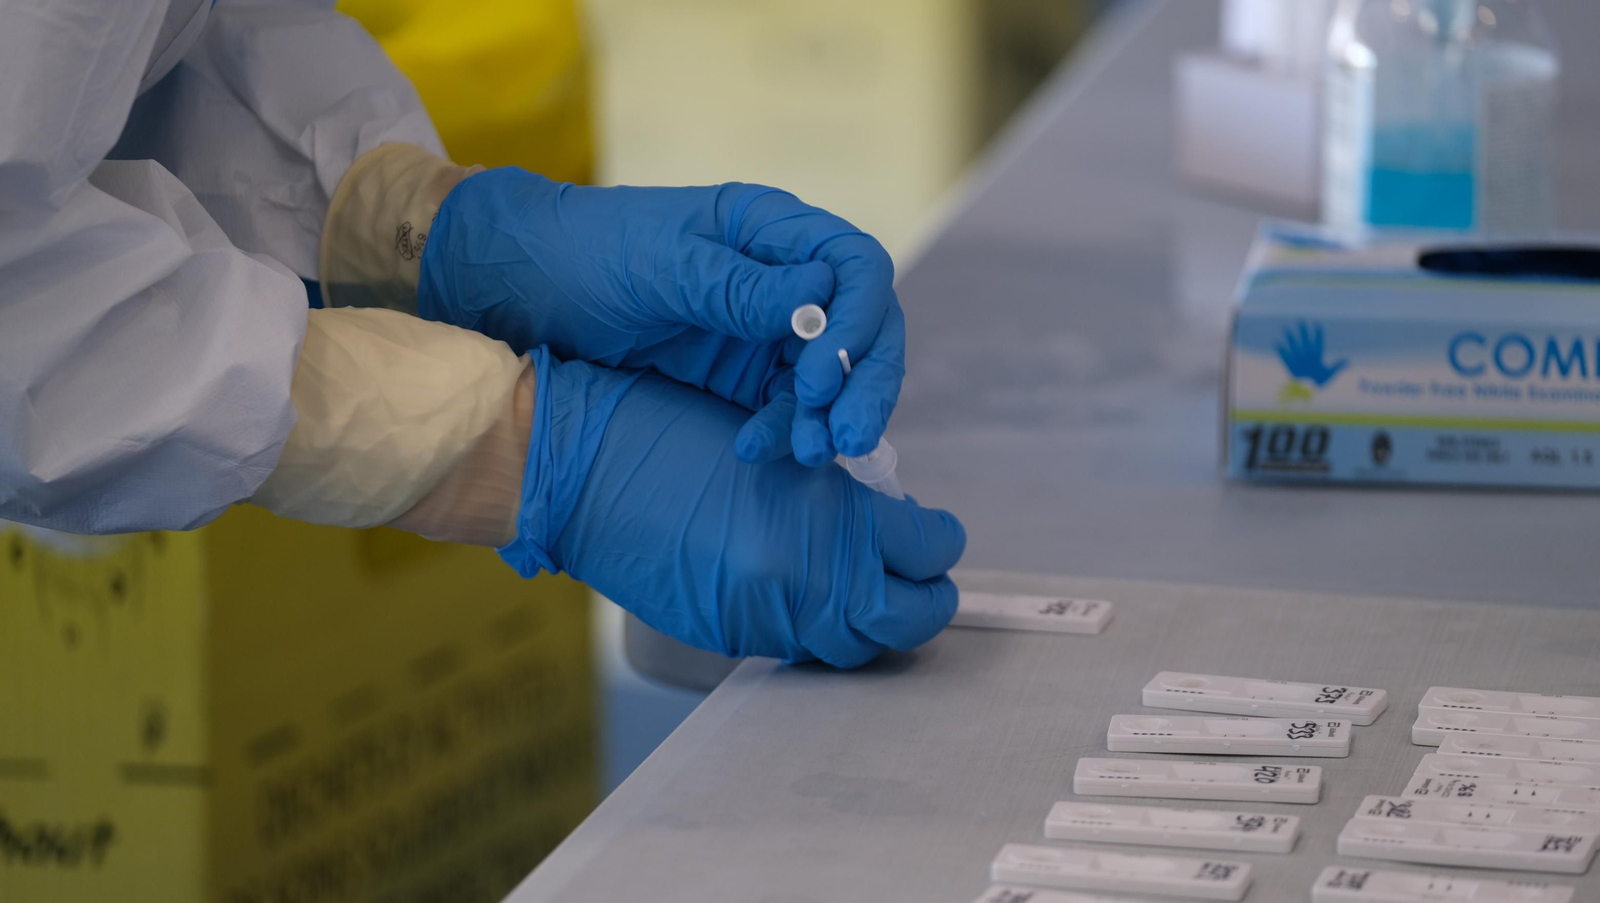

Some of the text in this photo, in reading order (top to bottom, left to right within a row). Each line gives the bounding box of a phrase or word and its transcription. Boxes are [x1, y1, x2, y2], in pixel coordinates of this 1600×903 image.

[1448, 331, 1600, 379] COM
[1241, 425, 1332, 470] 100
[1287, 719, 1317, 740] 533
[1254, 766, 1283, 784] 420
